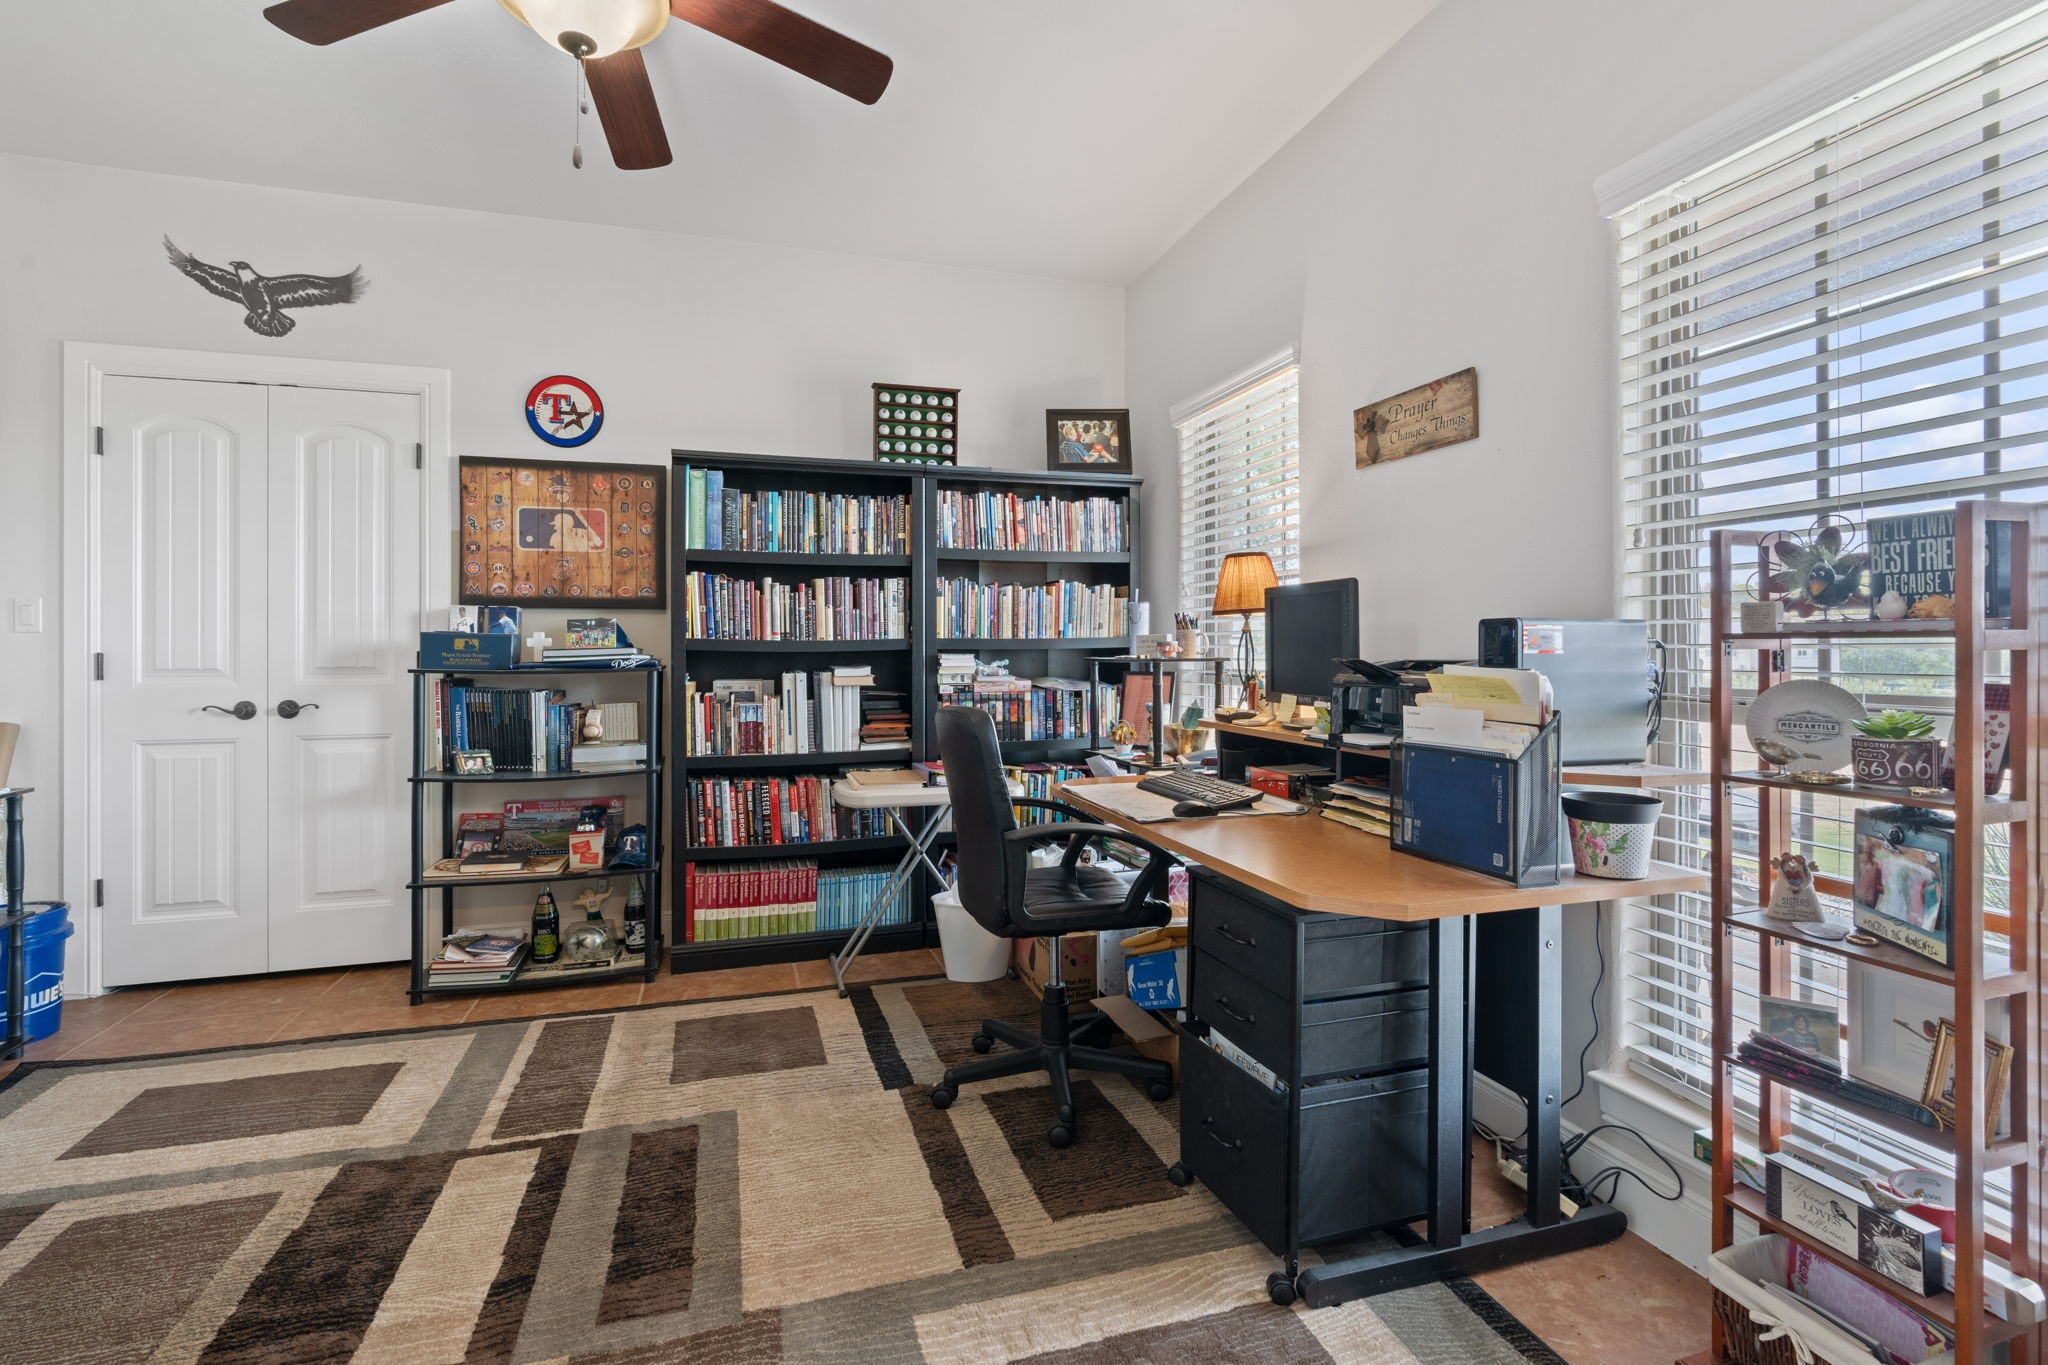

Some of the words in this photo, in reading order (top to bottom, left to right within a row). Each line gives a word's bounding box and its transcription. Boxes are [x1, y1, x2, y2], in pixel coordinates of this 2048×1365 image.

[543, 393, 571, 424] T
[1388, 397, 1438, 425] Prayer
[1389, 425, 1427, 445] Changes
[1871, 519, 1906, 542] WE'LL
[1912, 513, 1956, 539] ALWAY
[1870, 540, 1911, 574] BEST
[1885, 572, 1942, 594] BECAUSE
[1781, 722, 1837, 731] MERCANTILE
[1858, 760, 1885, 776] 66
[1895, 751, 1932, 780] 66
[761, 785, 770, 815] FLEECED
[507, 803, 522, 820] T
[624, 836, 637, 850] T
[1782, 897, 1810, 907] SISTERS
[24, 979, 64, 1011] WE'S
[1793, 1153, 1825, 1171] PREMPRO
[1798, 1187, 1828, 1207] friend
[1803, 1202, 1842, 1227] LOVES
